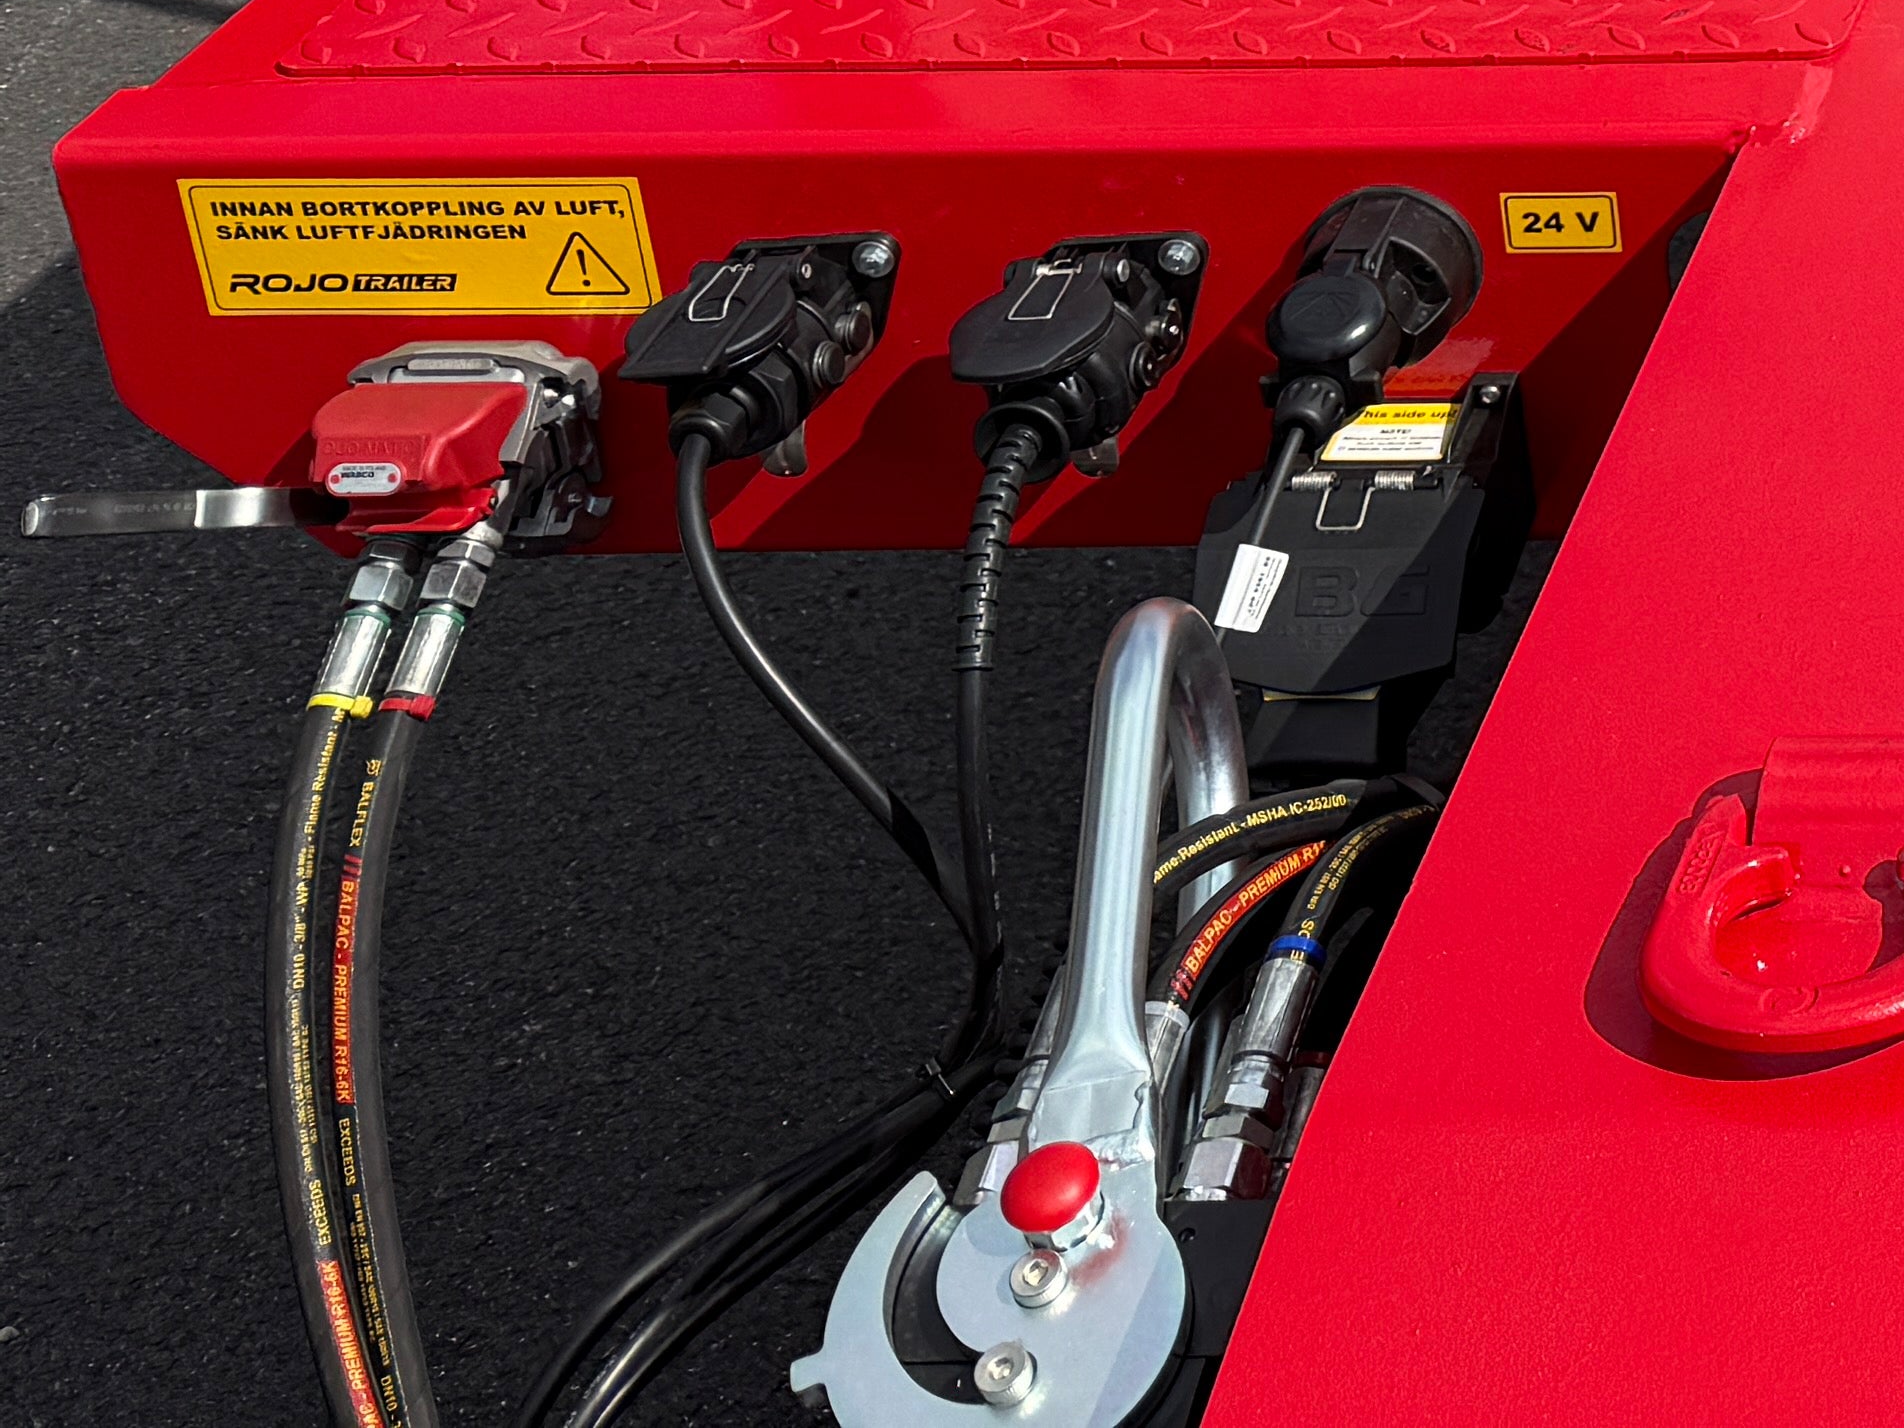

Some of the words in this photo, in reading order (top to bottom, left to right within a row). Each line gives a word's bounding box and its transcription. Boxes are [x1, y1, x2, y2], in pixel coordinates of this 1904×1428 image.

[209, 200, 294, 217] INNAN
[302, 200, 505, 217] BORTKOPPLING
[513, 199, 546, 216] AV
[555, 199, 626, 219] LUFT,
[216, 223, 289, 240] SÄNK
[296, 222, 527, 240] LUFTFJÄDRINGEN
[1521, 211, 1565, 233] 24
[1575, 211, 1599, 233] V
[1363, 409, 1387, 418] his
[1392, 409, 1426, 418] side
[311, 731, 338, 792] Resistant
[350, 781, 376, 847] BALFLEX
[1153, 857, 1180, 884] ame
[1177, 822, 1241, 861] Resistant
[1245, 805, 1288, 828] MSHA
[335, 880, 355, 950] BALPAC
[1185, 908, 1234, 974] BALPAC
[1238, 853, 1301, 907] PREMIUM
[333, 964, 348, 1041] PREMIUM
[333, 1045, 351, 1105] R16-6K
[308, 1178, 332, 1246] EXCEEDS
[338, 1116, 358, 1187] EXCEEDS
[380, 1374, 398, 1412] DN10
[333, 1318, 370, 1391] PREMIUM
